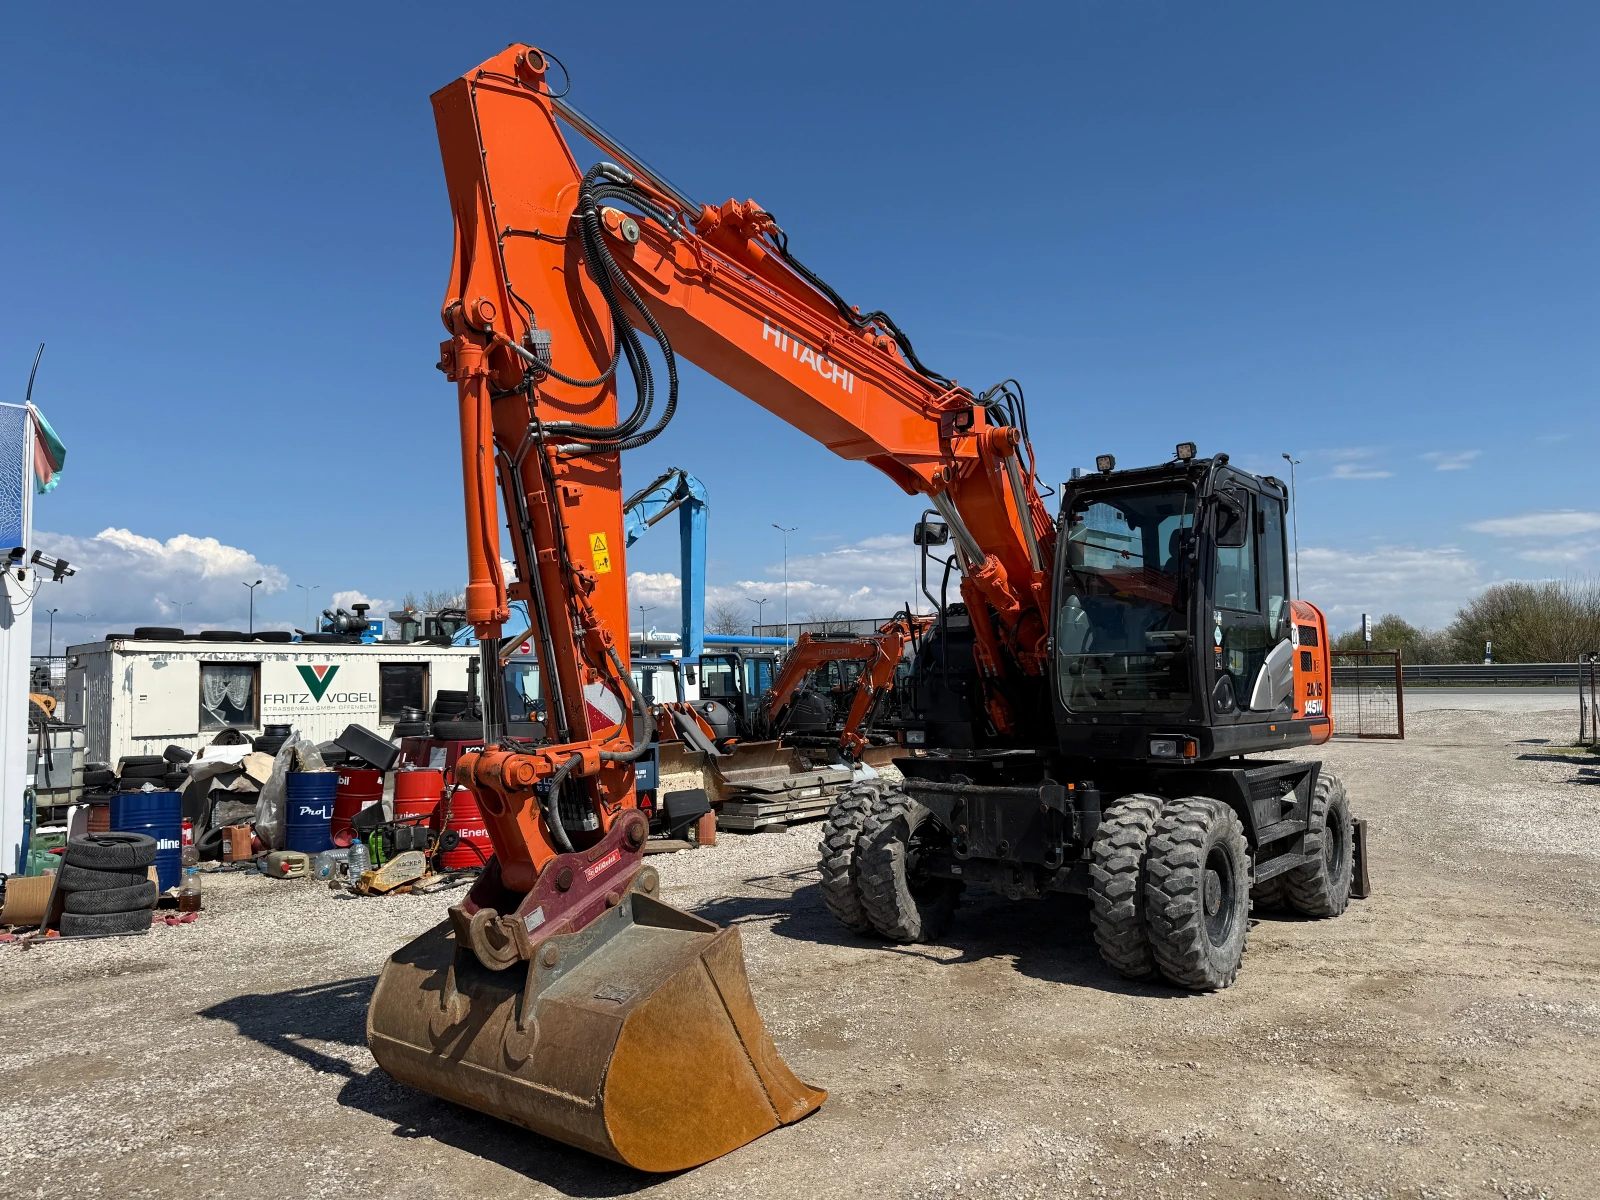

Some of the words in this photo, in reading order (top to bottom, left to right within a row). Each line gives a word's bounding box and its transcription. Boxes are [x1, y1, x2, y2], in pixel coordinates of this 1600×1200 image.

[762, 316, 855, 394] HITACHI
[818, 648, 851, 656] HITACHI
[263, 693, 310, 704] FRITZ
[326, 692, 377, 703] VOGEL
